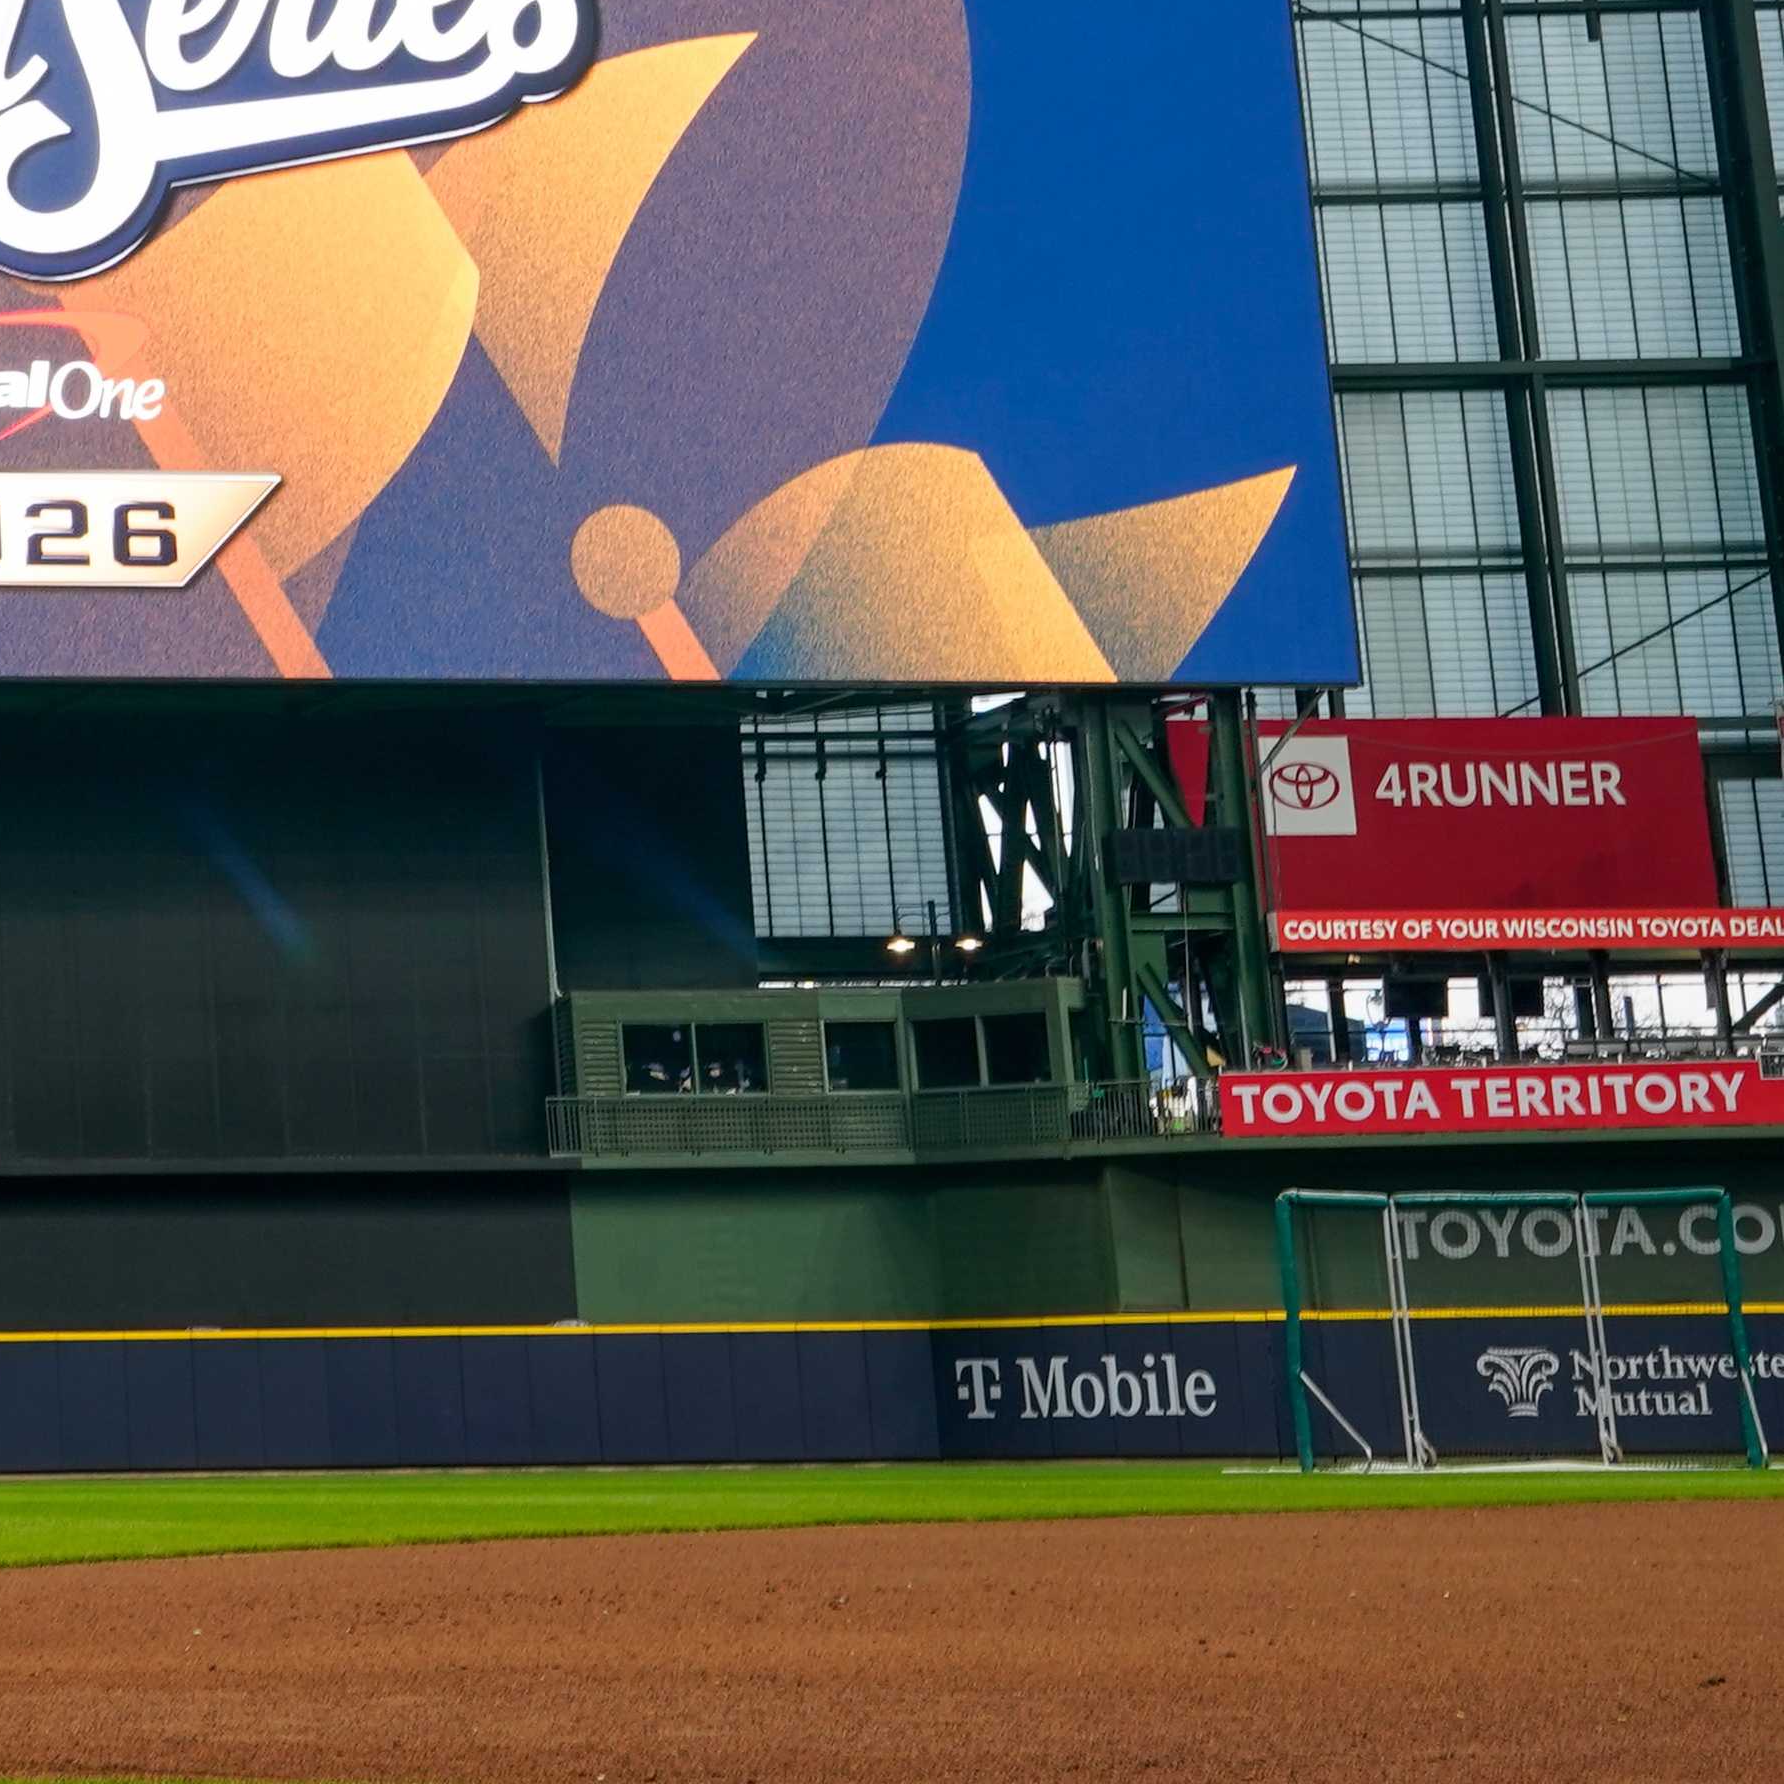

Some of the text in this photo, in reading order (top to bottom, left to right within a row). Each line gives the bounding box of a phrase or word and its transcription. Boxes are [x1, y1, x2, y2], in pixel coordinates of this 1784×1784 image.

[1374, 760, 1627, 808] 4RUNNER
[1283, 919, 1397, 941] COURTESY
[1402, 918, 1434, 939] OF
[1437, 917, 1500, 939] YOUR
[1502, 917, 1634, 938] WISCONSIN
[1637, 916, 1726, 938] TOYOTA
[1232, 1071, 1746, 1125] TOYOTA TERRITORY
[1396, 1202, 1784, 1261] TOYOTA.CO
[1018, 1353, 1217, 1418] Mobile
[1569, 1345, 1784, 1381] Northwete
[1573, 1382, 1713, 1417] Mutual
